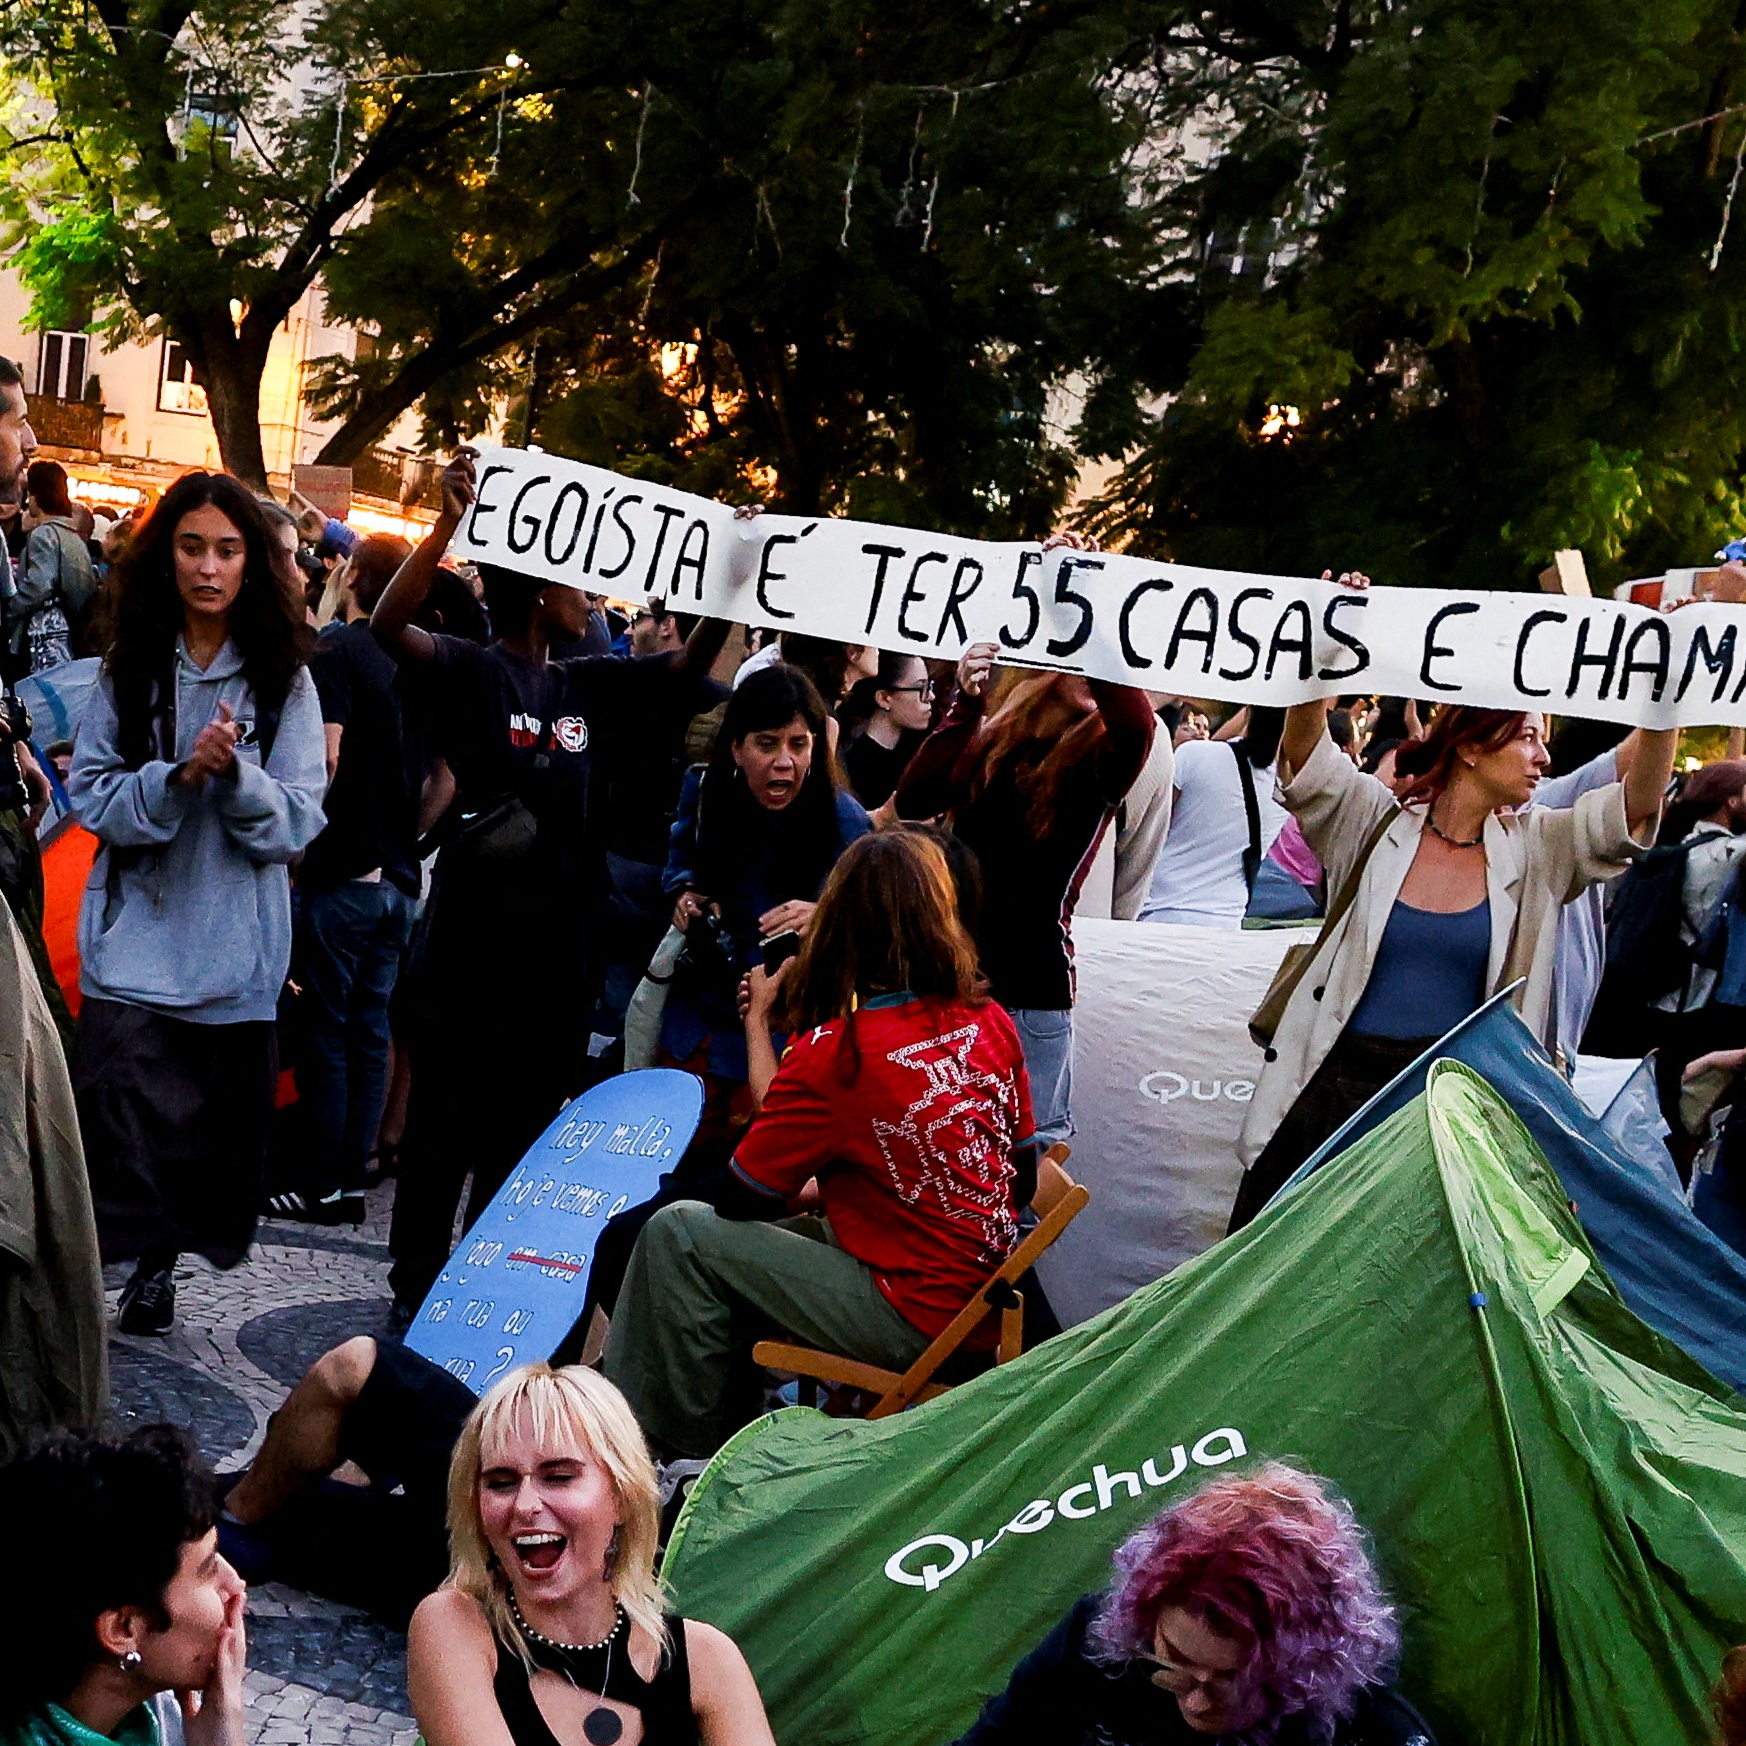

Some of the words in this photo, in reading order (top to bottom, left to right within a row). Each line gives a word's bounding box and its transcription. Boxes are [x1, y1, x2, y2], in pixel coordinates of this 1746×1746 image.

[467, 464, 709, 601] EGOÍSTA
[757, 522, 821, 619] É
[860, 543, 984, 647] TER
[998, 547, 1106, 658] 55
[1118, 578, 1371, 682] CASAS
[1419, 602, 1481, 692] E
[1138, 1070, 1256, 1105] Que
[549, 1105, 606, 1164] hey
[603, 1115, 673, 1163] malta,
[502, 1166, 552, 1222] hoje
[551, 1180, 610, 1218] vemos
[440, 1233, 504, 1285] jogo
[540, 1250, 588, 1284] casa
[424, 1298, 454, 1324] na
[457, 1298, 496, 1330] rua
[502, 1308, 535, 1337] ou
[883, 1426, 1249, 1593] Quechua
